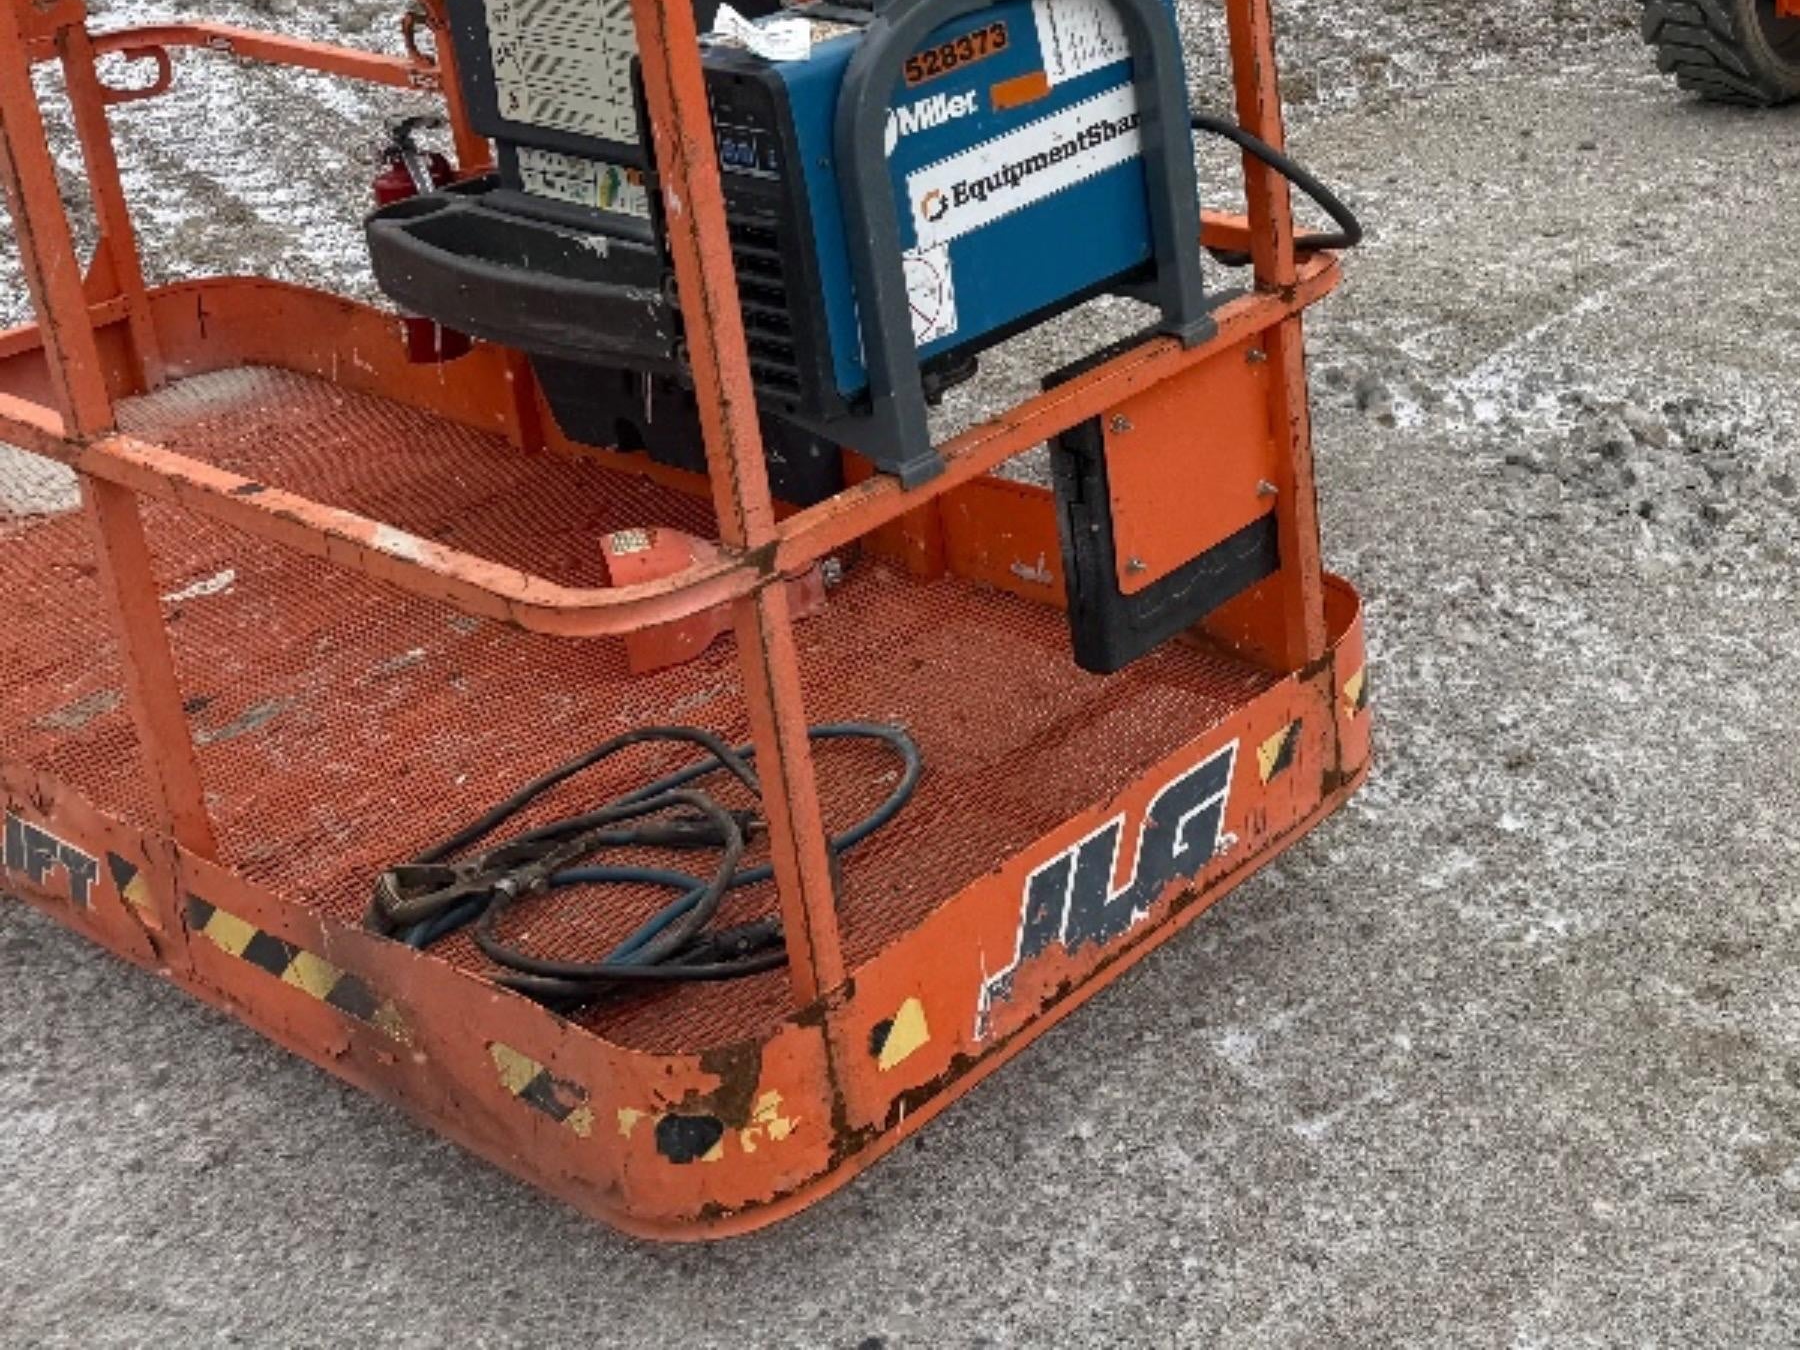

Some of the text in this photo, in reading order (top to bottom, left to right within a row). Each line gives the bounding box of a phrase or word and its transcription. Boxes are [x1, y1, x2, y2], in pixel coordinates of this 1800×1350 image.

[904, 23, 1008, 83] 528373
[897, 89, 979, 137] Miller
[951, 112, 1140, 208] EquipmentShar
